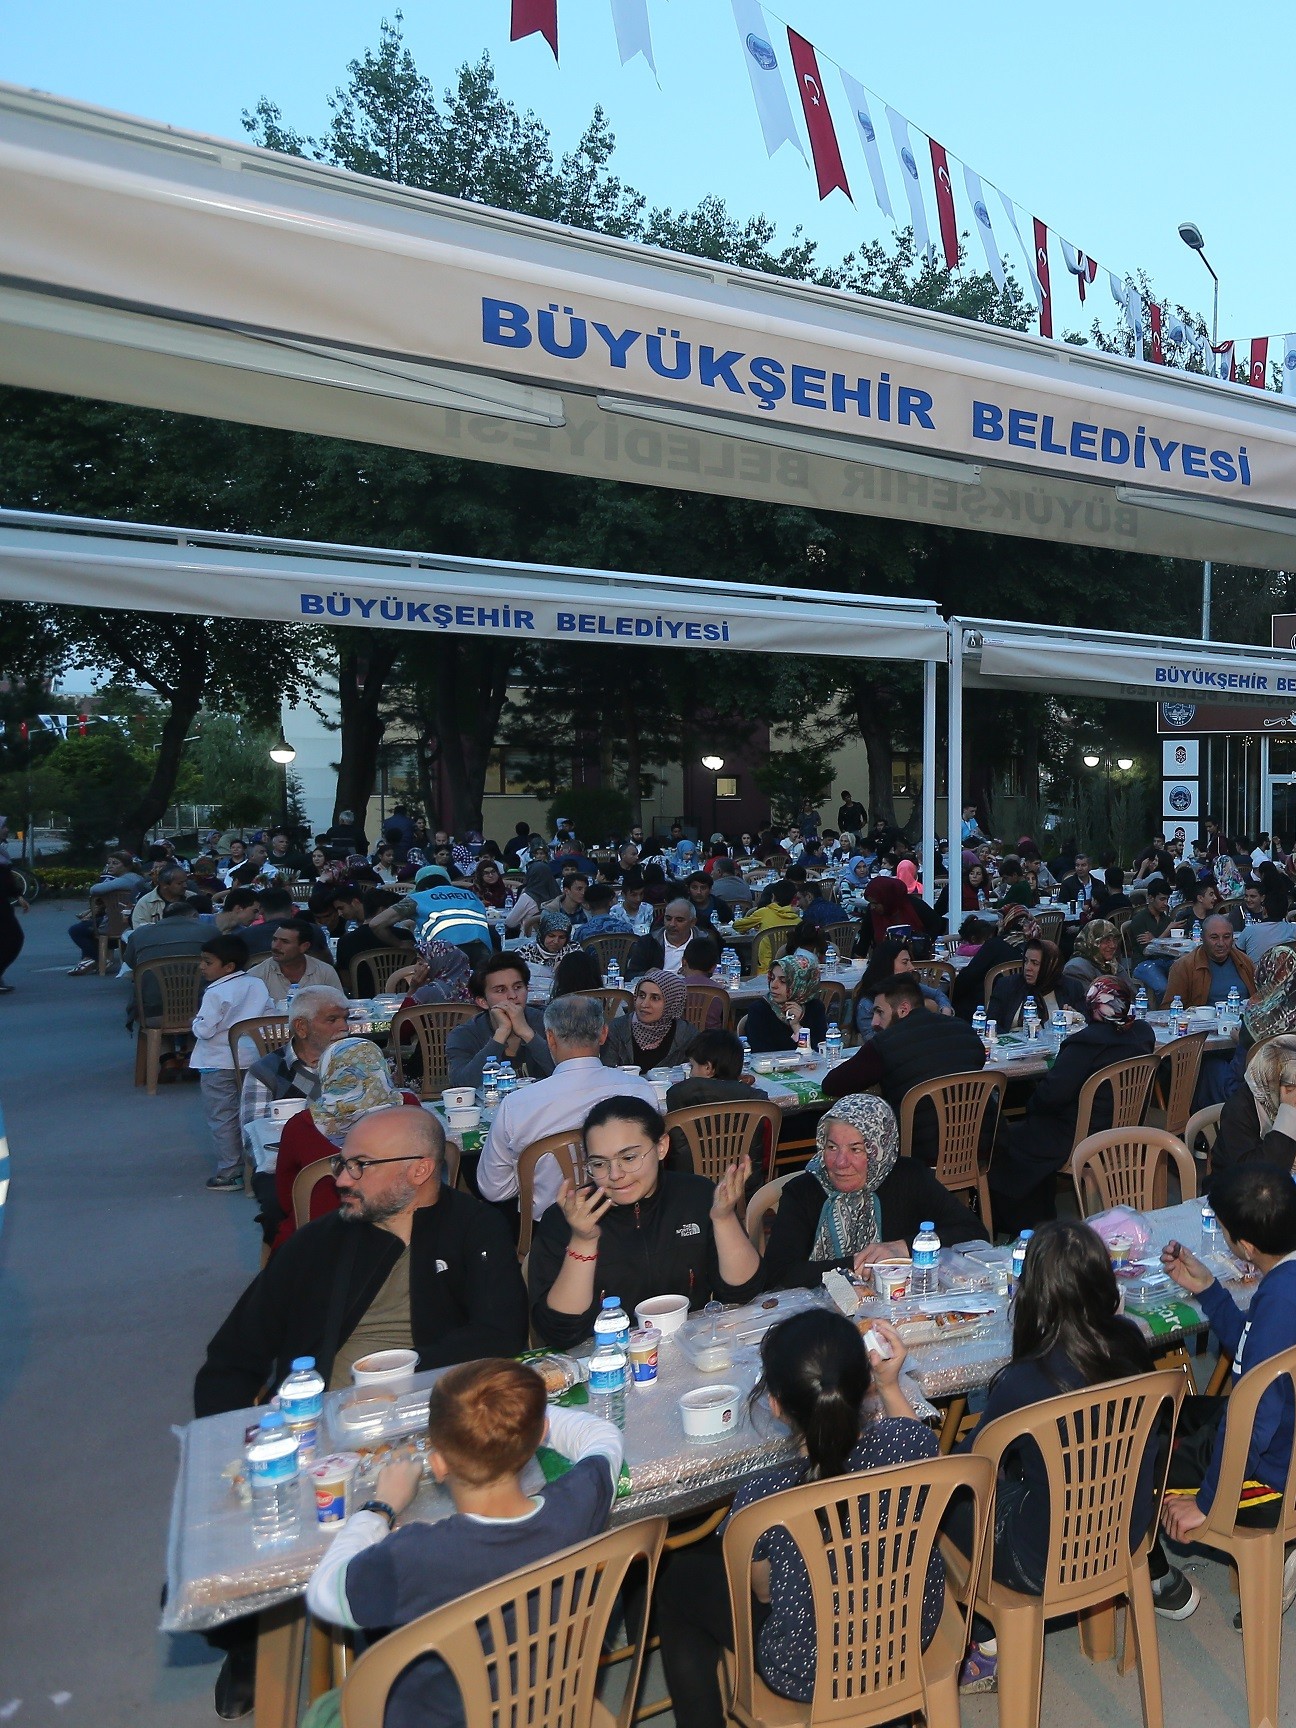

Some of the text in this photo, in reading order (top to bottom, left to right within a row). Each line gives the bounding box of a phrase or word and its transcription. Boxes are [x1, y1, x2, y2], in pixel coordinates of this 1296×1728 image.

[482, 296, 1252, 486] BÜYÜKŞEHİR BELEDİYESİ
[300, 592, 731, 642] BÜYÜKŞEHİR BELEDİYESİ
[1155, 667, 1268, 690] BÜYÜKŞEHİR
